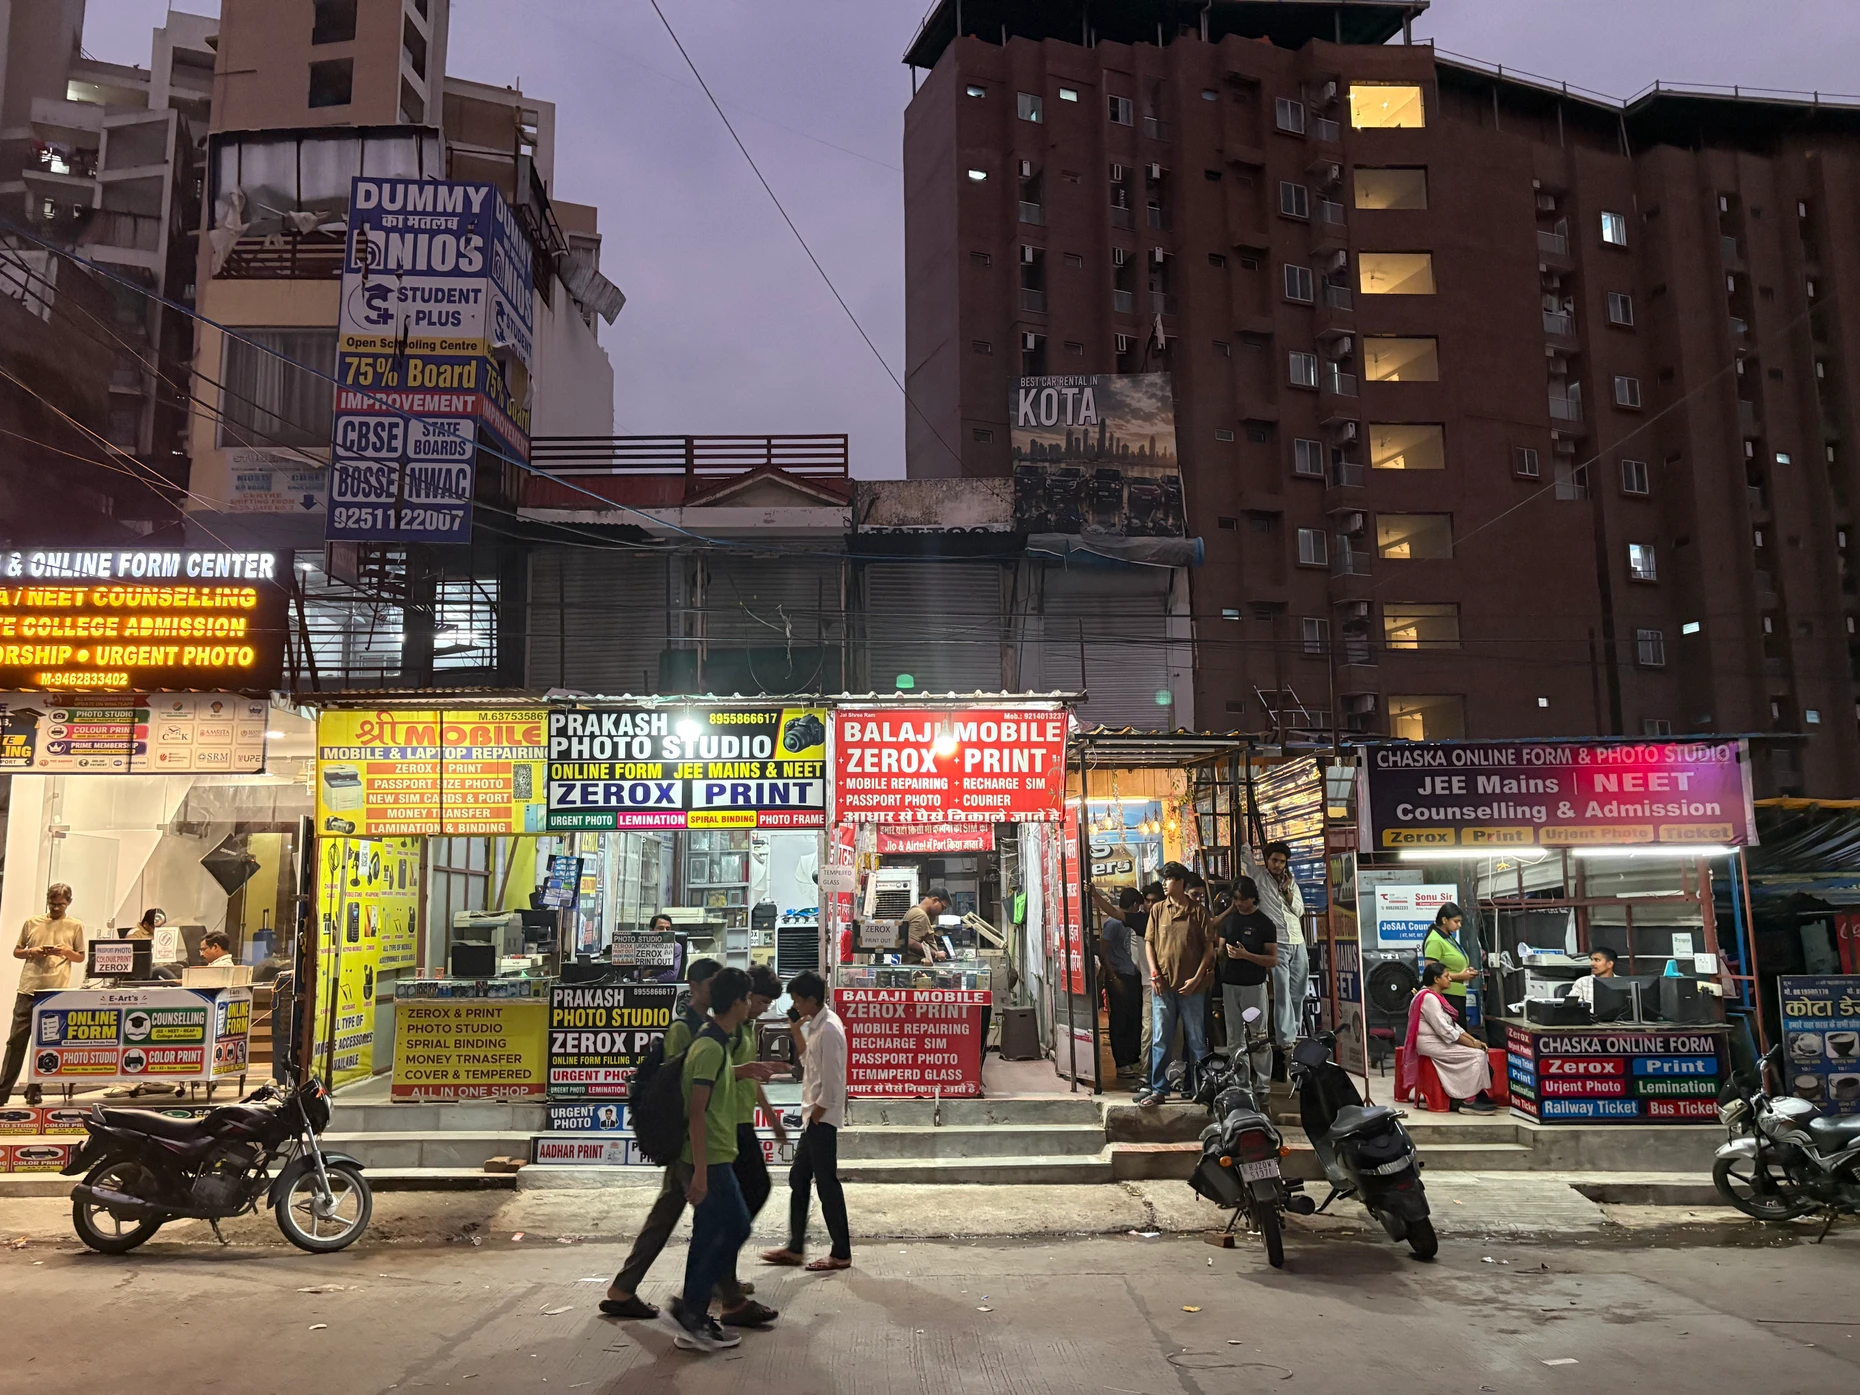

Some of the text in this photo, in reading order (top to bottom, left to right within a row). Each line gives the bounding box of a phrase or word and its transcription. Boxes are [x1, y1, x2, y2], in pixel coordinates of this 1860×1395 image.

[356, 181, 490, 214] DUMMY
[381, 214, 459, 230] का मतलब
[387, 232, 483, 273] NIOS
[397, 286, 482, 305] STUDENT
[415, 310, 461, 327] PLUS
[346, 337, 477, 351] Open Centre
[344, 357, 477, 388] 75% Board
[1020, 376, 1098, 387] BEST CAR RENTAL IN
[340, 391, 476, 412] IMPROVEMENT
[1018, 387, 1099, 427] KOTA
[422, 421, 460, 437] STATE
[342, 420, 399, 454] CBSE
[413, 439, 466, 456] BOARDS
[338, 465, 397, 498] BOSSE
[408, 467, 467, 499] NWAC
[334, 507, 464, 531] 9251122007
[8, 552, 275, 578] & ONLINE FORM CENTER
[27, 586, 89, 607] NEET
[93, 587, 257, 608] COUNSELLING
[22, 617, 248, 638] COLLEGE ADMISSION
[96, 646, 179, 666] URGENT
[182, 647, 254, 666] PHOTO
[40, 673, 129, 686] M-9462833402
[76, 710, 134, 718] PHOTO STUDIO
[709, 713, 777, 725] 8955866617
[73, 726, 108, 734] COLOUR
[550, 712, 667, 736] PRAKASH
[404, 725, 541, 746] MOBILE
[844, 721, 1061, 743] BALAJI MOBILE
[550, 735, 772, 760] PHOTO STUDIO
[846, 748, 1047, 773] ZEROX PRINT
[395, 763, 483, 774] ZEROX PRINT
[551, 761, 823, 780] ONLINE FORM JEE MAINS & NEET
[374, 778, 433, 789] PASSPORT
[467, 778, 504, 788] PHOTO
[846, 777, 1046, 790] MOBILE REPAIRING RECHARGE SIM
[1417, 771, 1695, 796] JEE Mains NEET
[369, 794, 396, 804] NEW
[399, 794, 426, 804] SIM
[466, 793, 474, 803] &
[478, 793, 509, 803] PORT
[556, 782, 676, 805] ZEROX
[705, 781, 814, 805] PRINT
[845, 794, 1011, 807] PASSPORT PHOTO COURIER
[387, 808, 427, 819] MONEY
[1395, 799, 1722, 823] Counselling & Admission
[550, 815, 613, 826] URGENT PHOTO
[619, 814, 685, 826] LEMINATION
[690, 815, 755, 824] SPIRAL BINDING
[759, 814, 824, 824] PHOTO FRAME
[371, 822, 506, 834] LAMINATION & BINDING
[1390, 825, 1730, 844] Zerox Print Urjent Photo Ticket
[1415, 893, 1453, 901] Sonu Sir
[865, 925, 891, 933] ZEROX
[1382, 922, 1406, 931] JoSAA
[842, 990, 984, 1003] BALAJI MOBILE
[1785, 996, 1833, 1017] कोटा
[341, 1014, 364, 1030] TYPE OF
[553, 1008, 670, 1027] PHOTO STUDIO
[226, 1017, 248, 1035] FORM
[407, 1023, 503, 1034] PHOTO STUDIO
[852, 1023, 970, 1035] MOBILE REPAIRING
[406, 1038, 507, 1049] SPRIAL BINDING
[551, 1032, 627, 1054] ZEROX
[852, 1037, 947, 1049] RECHARGE SIM
[149, 1050, 202, 1063] COLOR PRINT
[406, 1054, 522, 1065] MONEY TRNASFER
[552, 1055, 630, 1065] ONLINE FORM FILLING
[1548, 1059, 1616, 1073] Zerox
[1646, 1059, 1705, 1072] Print
[405, 1069, 532, 1080] COVER & TEMPERED
[553, 1070, 600, 1081] URGENT
[851, 1069, 962, 1081] TEMMPERD GLASS
[411, 1086, 529, 1097] ALL IN ONE SHOP
[1545, 1080, 1621, 1095] Urjent Photo
[1638, 1080, 1716, 1093] Lemination
[1545, 1100, 1637, 1116] Railway Ticket
[539, 1144, 604, 1159] AADHAR PRINT
